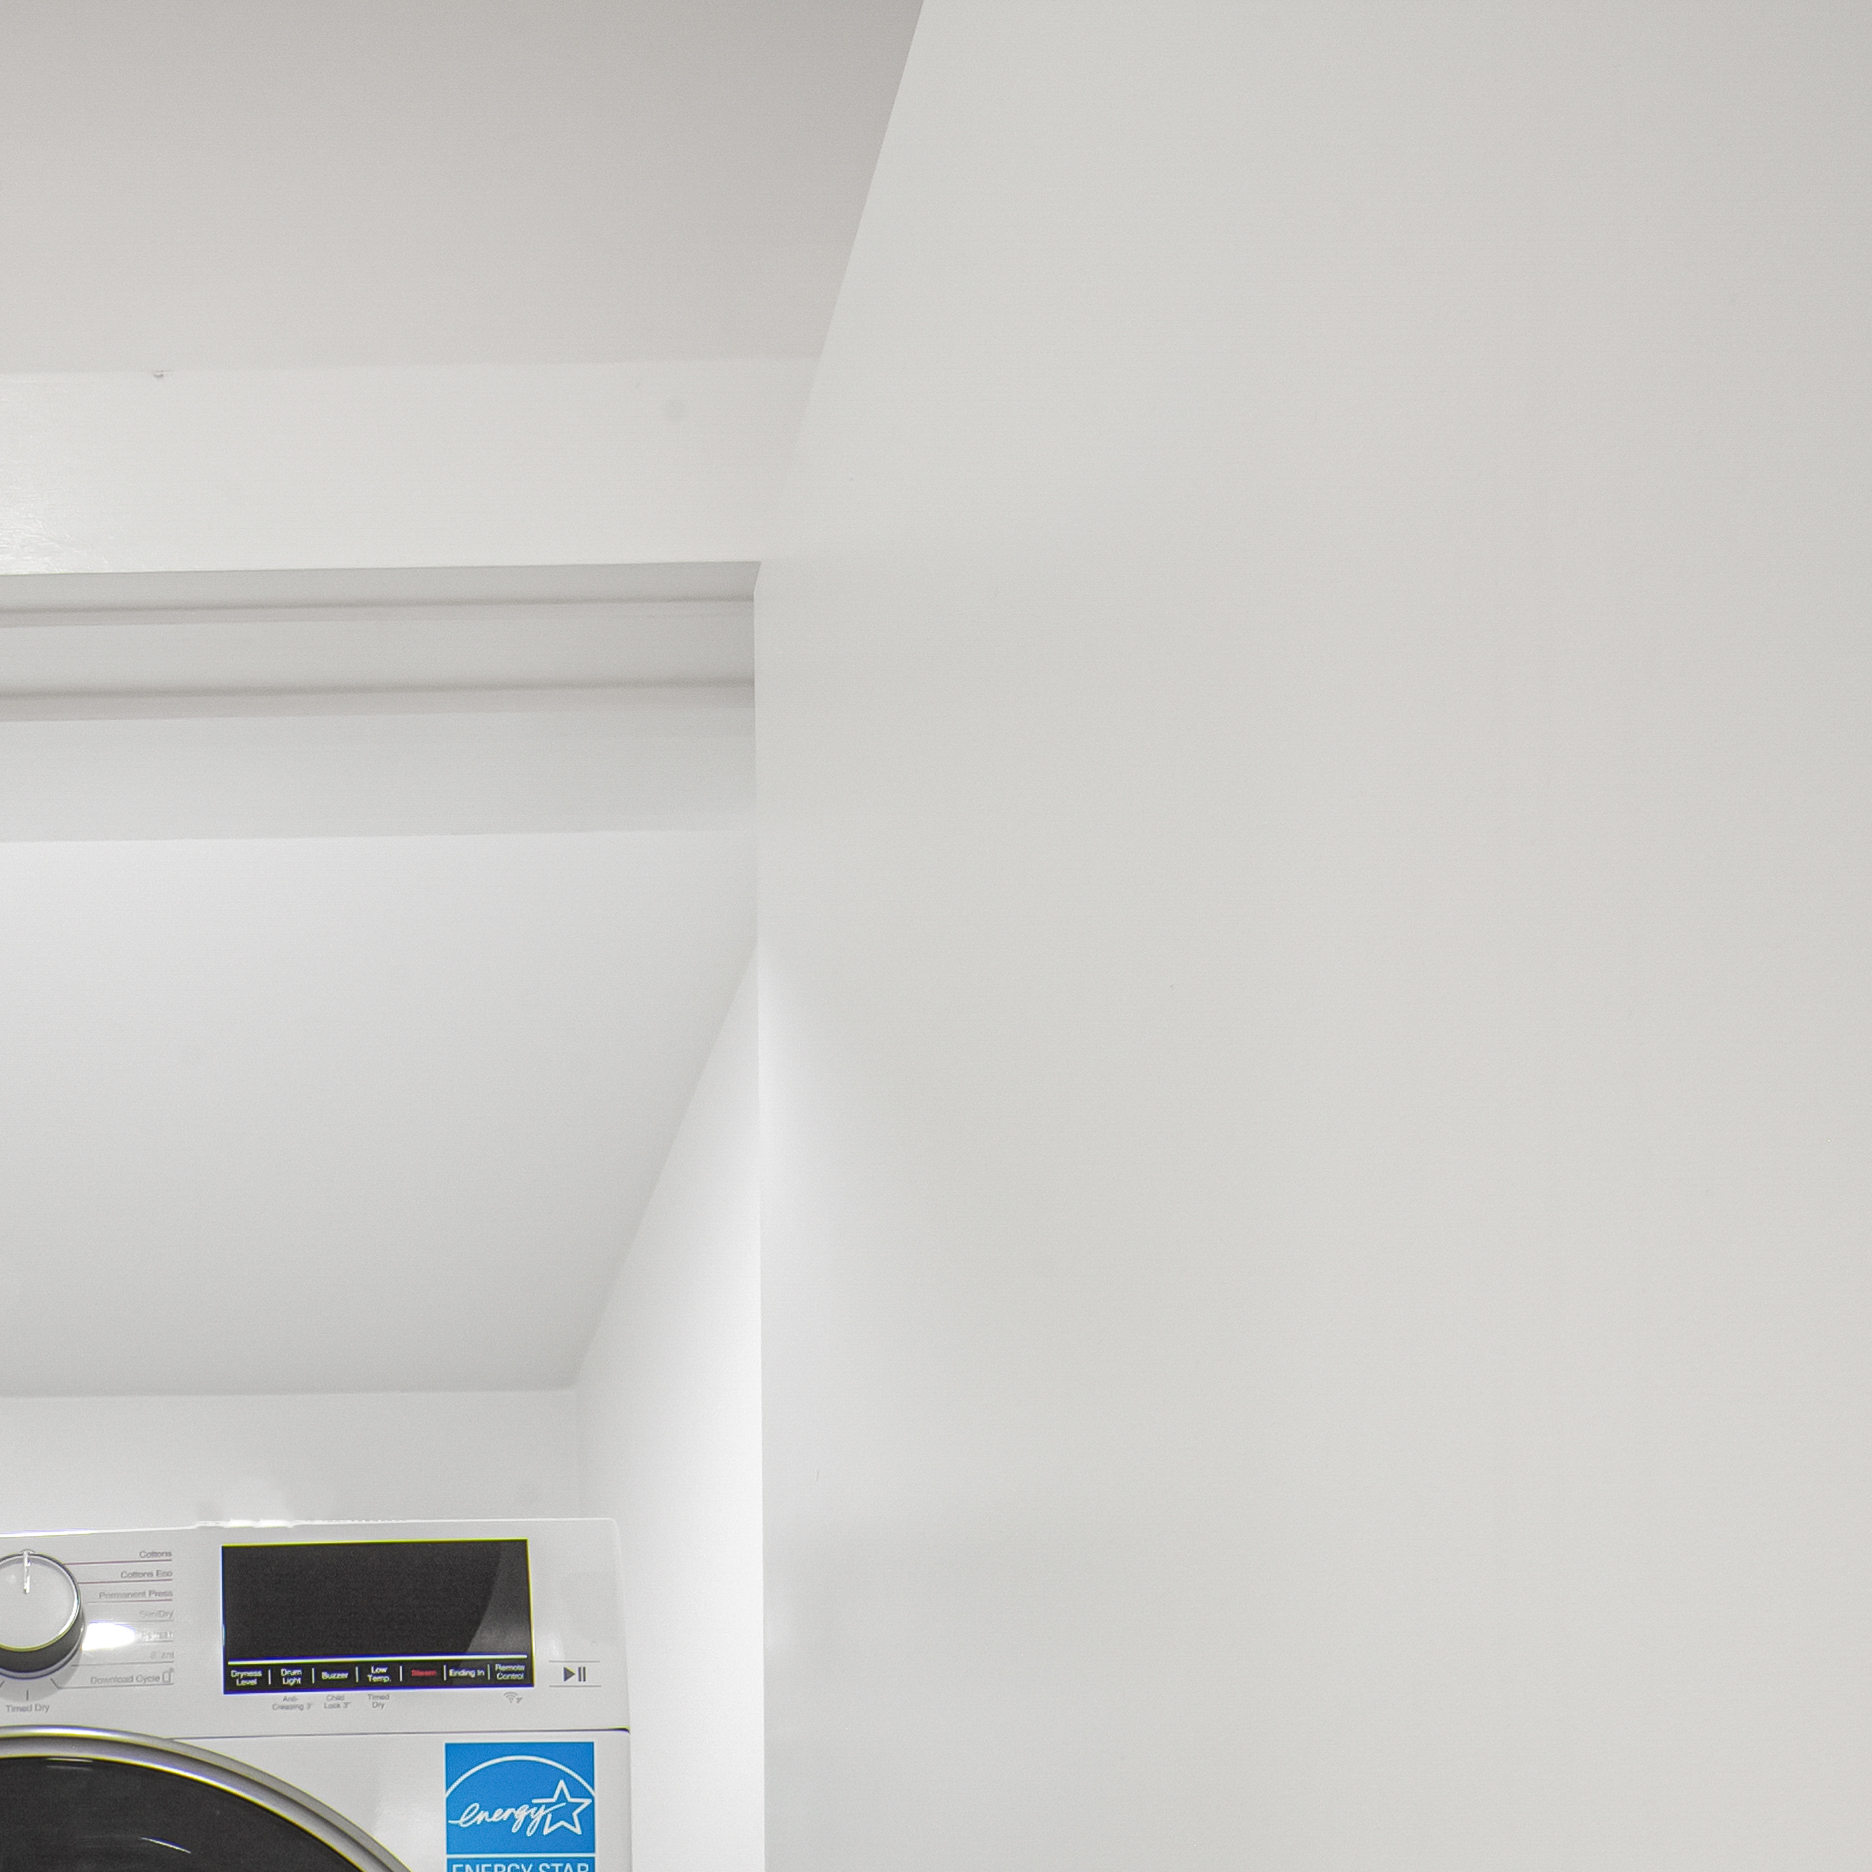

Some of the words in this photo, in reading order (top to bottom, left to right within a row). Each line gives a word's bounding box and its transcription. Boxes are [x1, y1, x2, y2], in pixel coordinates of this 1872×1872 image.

[139, 1550, 172, 1559] Cottons
[120, 1570, 153, 1579] Cottons
[156, 1569, 173, 1577] Eco
[98, 1591, 146, 1600] Permanent
[148, 1590, 173, 1598] Press
[280, 1668, 302, 1676] Drum
[370, 1665, 388, 1674] Low
[495, 1663, 525, 1672] Remote
[230, 1670, 262, 1678] Dryness
[321, 1671, 349, 1680] Buzzer
[449, 1668, 476, 1678] Ending
[496, 1672, 525, 1680] Control
[90, 1675, 133, 1684] Download
[135, 1674, 160, 1684] Cycle
[236, 1678, 257, 1686] Level
[282, 1677, 302, 1686] Light
[5, 1704, 32, 1712] Timed
[35, 1704, 50, 1713] Dry
[372, 1701, 385, 1709] Dry
[449, 1803, 556, 1836] energy
